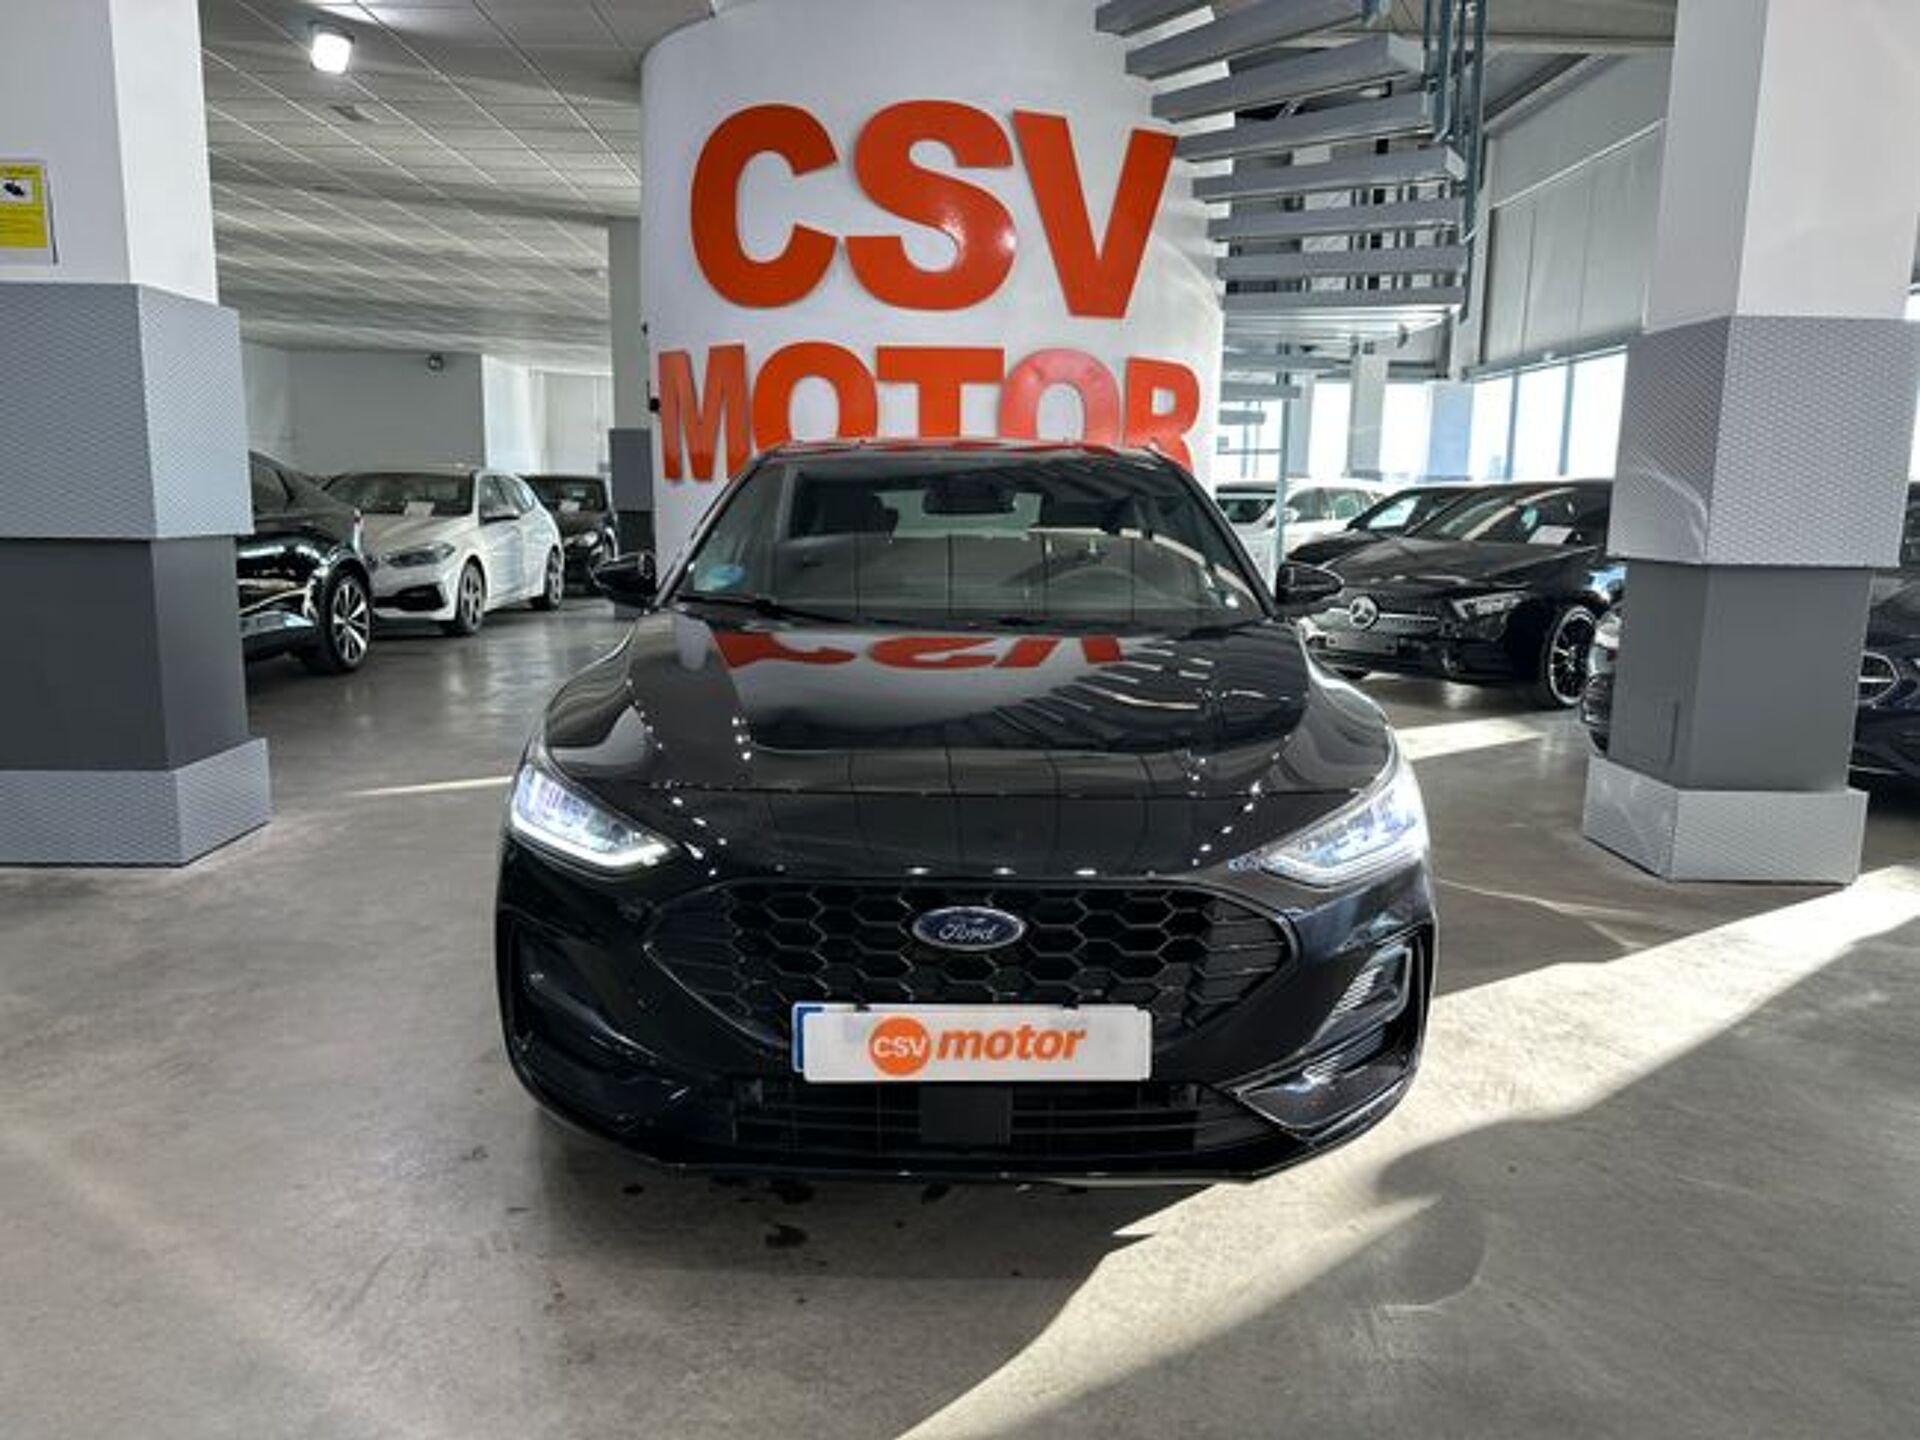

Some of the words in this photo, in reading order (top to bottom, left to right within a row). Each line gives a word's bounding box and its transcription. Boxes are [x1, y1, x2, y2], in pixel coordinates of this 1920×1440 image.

[690, 100, 1179, 320] CSV
[658, 342, 1201, 482] MOTOR
[938, 917, 1001, 941] Ford
[936, 1024, 1087, 1061] motor
